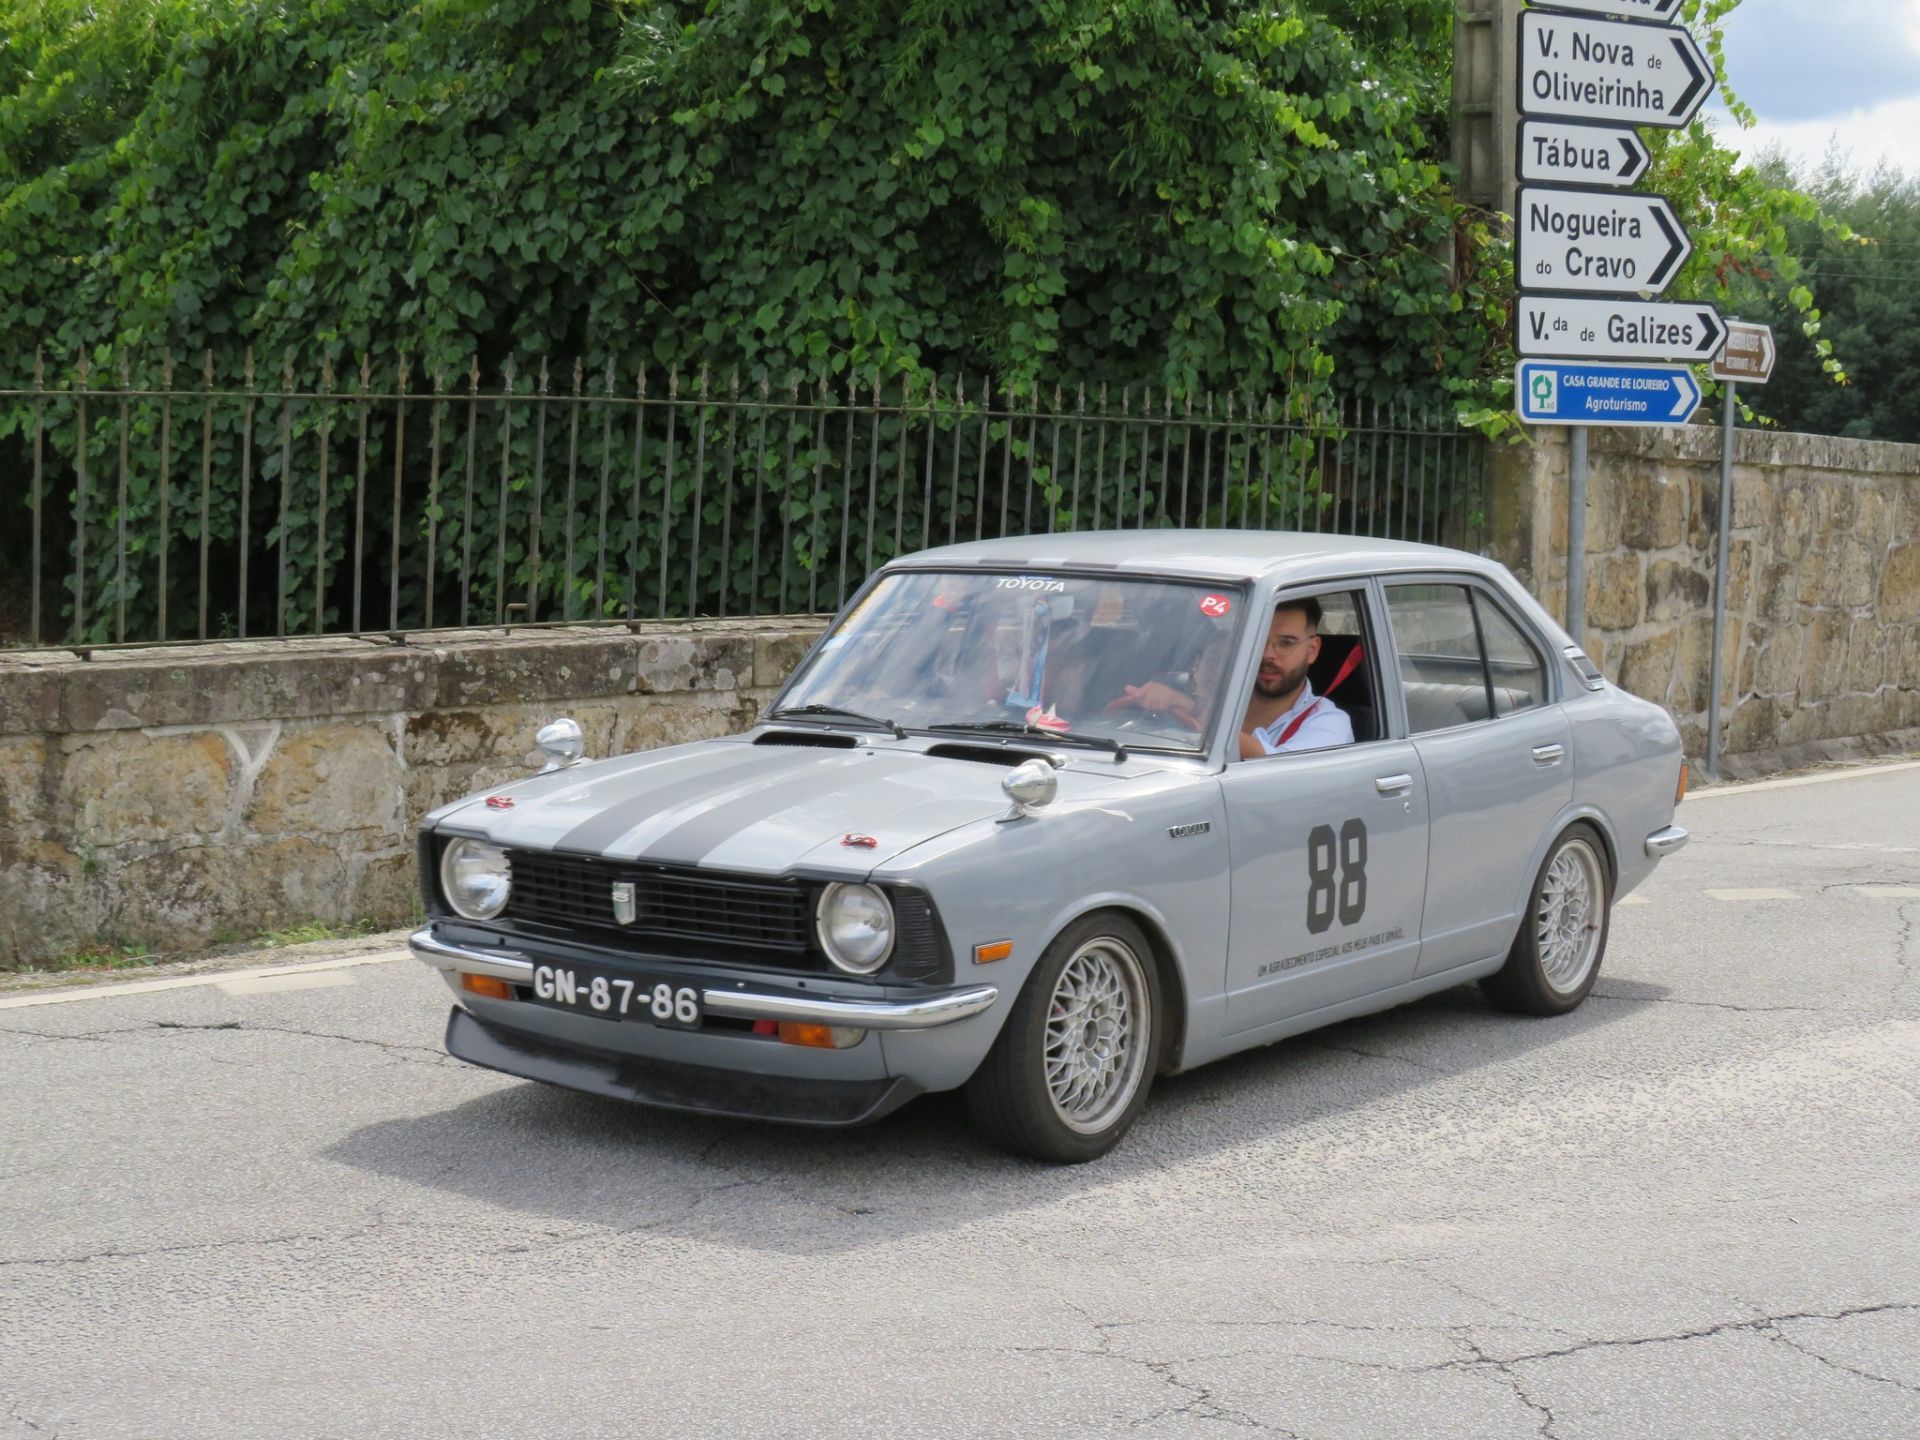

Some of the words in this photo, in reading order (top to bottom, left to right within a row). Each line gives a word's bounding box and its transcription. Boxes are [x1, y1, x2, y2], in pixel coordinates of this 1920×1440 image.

[1537, 28, 1559, 59] V.
[1572, 32, 1634, 67] Nova
[1647, 54, 1662, 69] de
[1533, 70, 1664, 110] Oliveirinha
[1533, 136, 1610, 170] Tábua
[1530, 203, 1641, 240] Nogueira
[1536, 260, 1552, 275] do
[1565, 247, 1636, 279] Cravo
[1529, 311, 1550, 341] V.
[1553, 316, 1568, 331] da
[1580, 327, 1595, 342] de
[1607, 314, 1693, 345] Galizes
[1563, 374, 1585, 387] CASA
[1587, 375, 1620, 389] GRANDE
[1621, 377, 1631, 389] DE
[1632, 378, 1670, 391] LOUREIRO
[1585, 396, 1647, 412] Agroturismo
[996, 577, 1065, 593] TOYOTA
[1201, 596, 1226, 614] P4
[1306, 817, 1368, 935] 88
[535, 965, 698, 1023] GN-87-86
